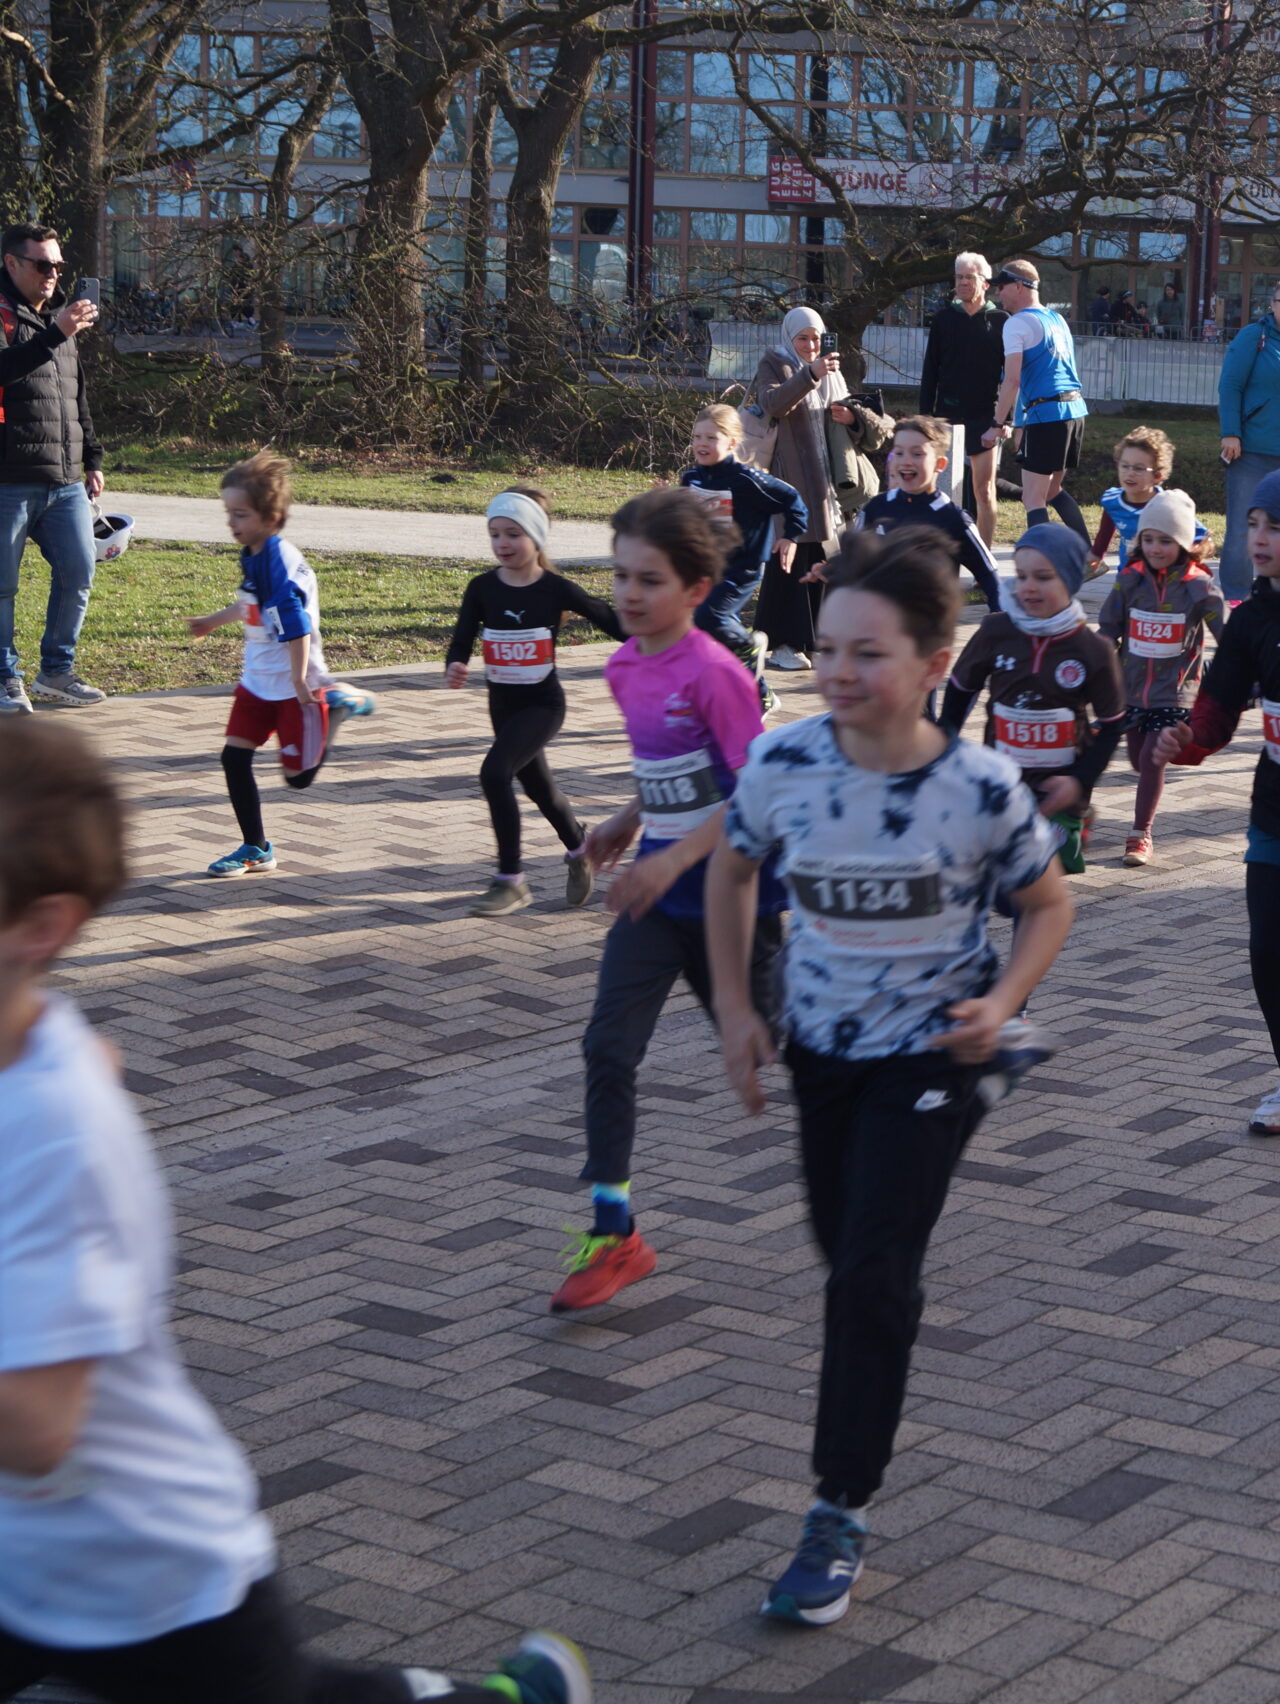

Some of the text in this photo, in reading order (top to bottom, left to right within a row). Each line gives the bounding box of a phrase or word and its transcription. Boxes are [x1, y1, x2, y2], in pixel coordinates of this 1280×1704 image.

[1136, 621, 1173, 639] 1524
[490, 642, 538, 661] 1502
[1004, 721, 1058, 744] 1518
[639, 775, 698, 806] 1118
[811, 878, 913, 913] 1134
